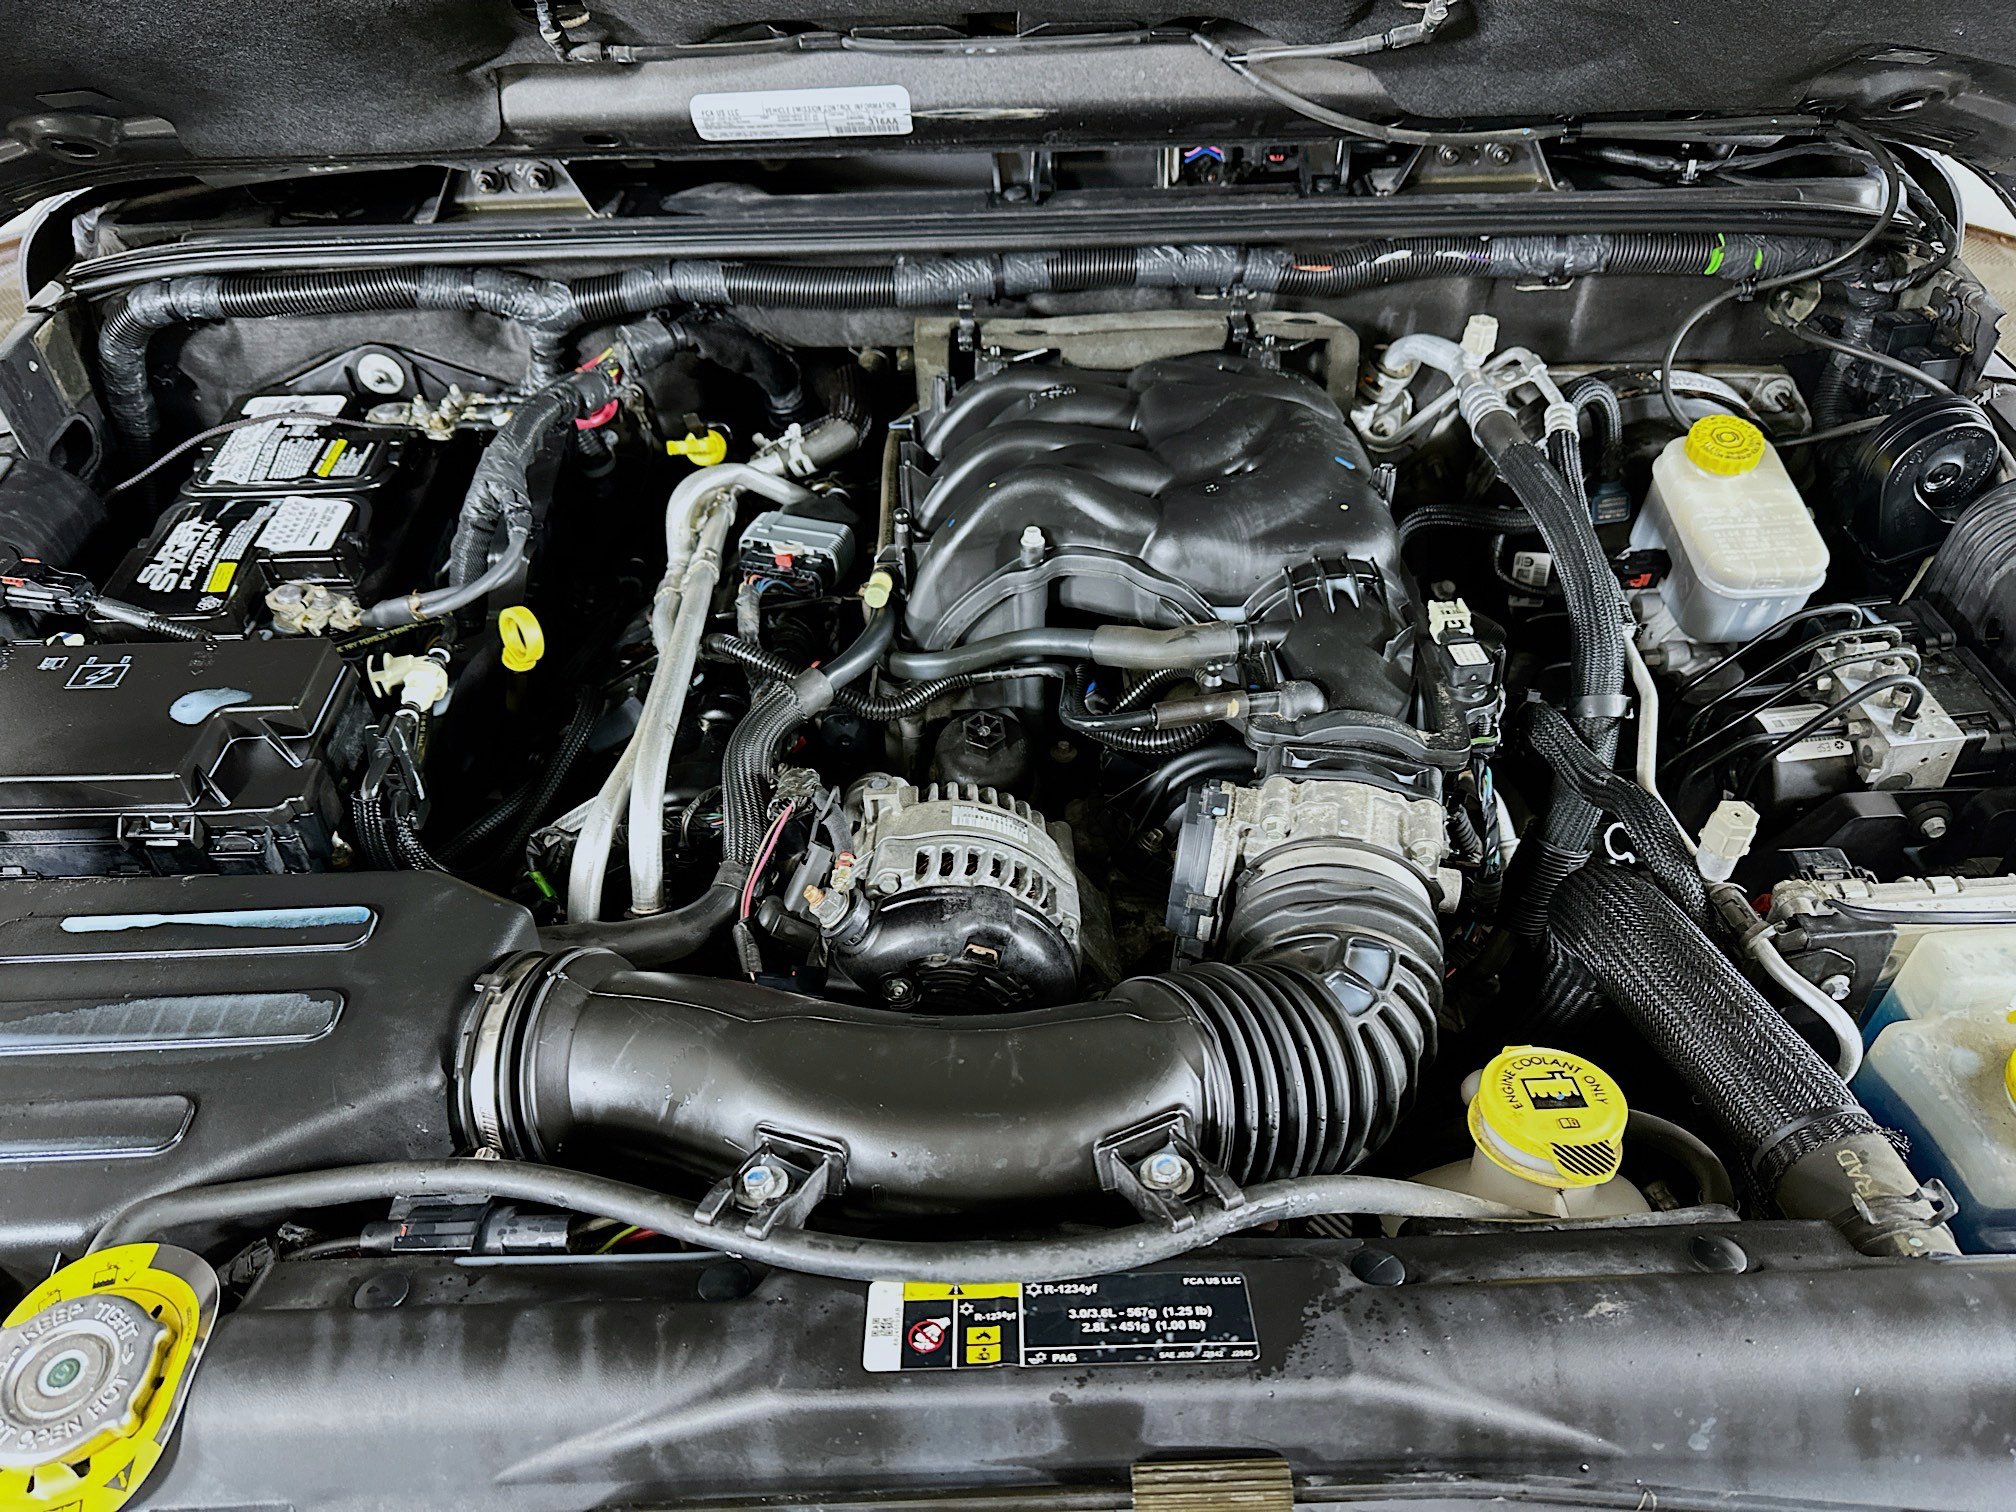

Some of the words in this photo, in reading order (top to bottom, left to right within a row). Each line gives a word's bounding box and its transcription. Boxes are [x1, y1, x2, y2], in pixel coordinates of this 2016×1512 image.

[136, 516, 202, 584] SUPER
[149, 520, 218, 593] START
[179, 527, 223, 590] PLATINUM
[1500, 1069, 1524, 1110] ENGINE
[1512, 1056, 1583, 1074] COOLANT
[1583, 1075, 1609, 1105] ONLY
[1043, 1283, 1099, 1296] R-1234yf
[1182, 1277, 1205, 1286] FCA
[1205, 1276, 1220, 1285] US
[1221, 1276, 1242, 1285] LLC
[19, 1303, 86, 1346] KEEP
[92, 1301, 141, 1341] TIGHT
[974, 1310, 1017, 1322] R-1234yf
[1068, 1307, 1118, 1319] 3.0/3.6L
[1126, 1307, 1158, 1319] 567g
[1162, 1305, 1194, 1319] (1.25
[1194, 1305, 1213, 1318] lb)
[1081, 1321, 1110, 1333] 2.8L
[1118, 1320, 1151, 1334] 451g
[1155, 1320, 1187, 1333] (1.00
[1187, 1319, 1207, 1333] lb)
[1051, 1352, 1078, 1363] PAG
[16, 1414, 84, 1451] OPEN
[86, 1374, 129, 1421] HOT
